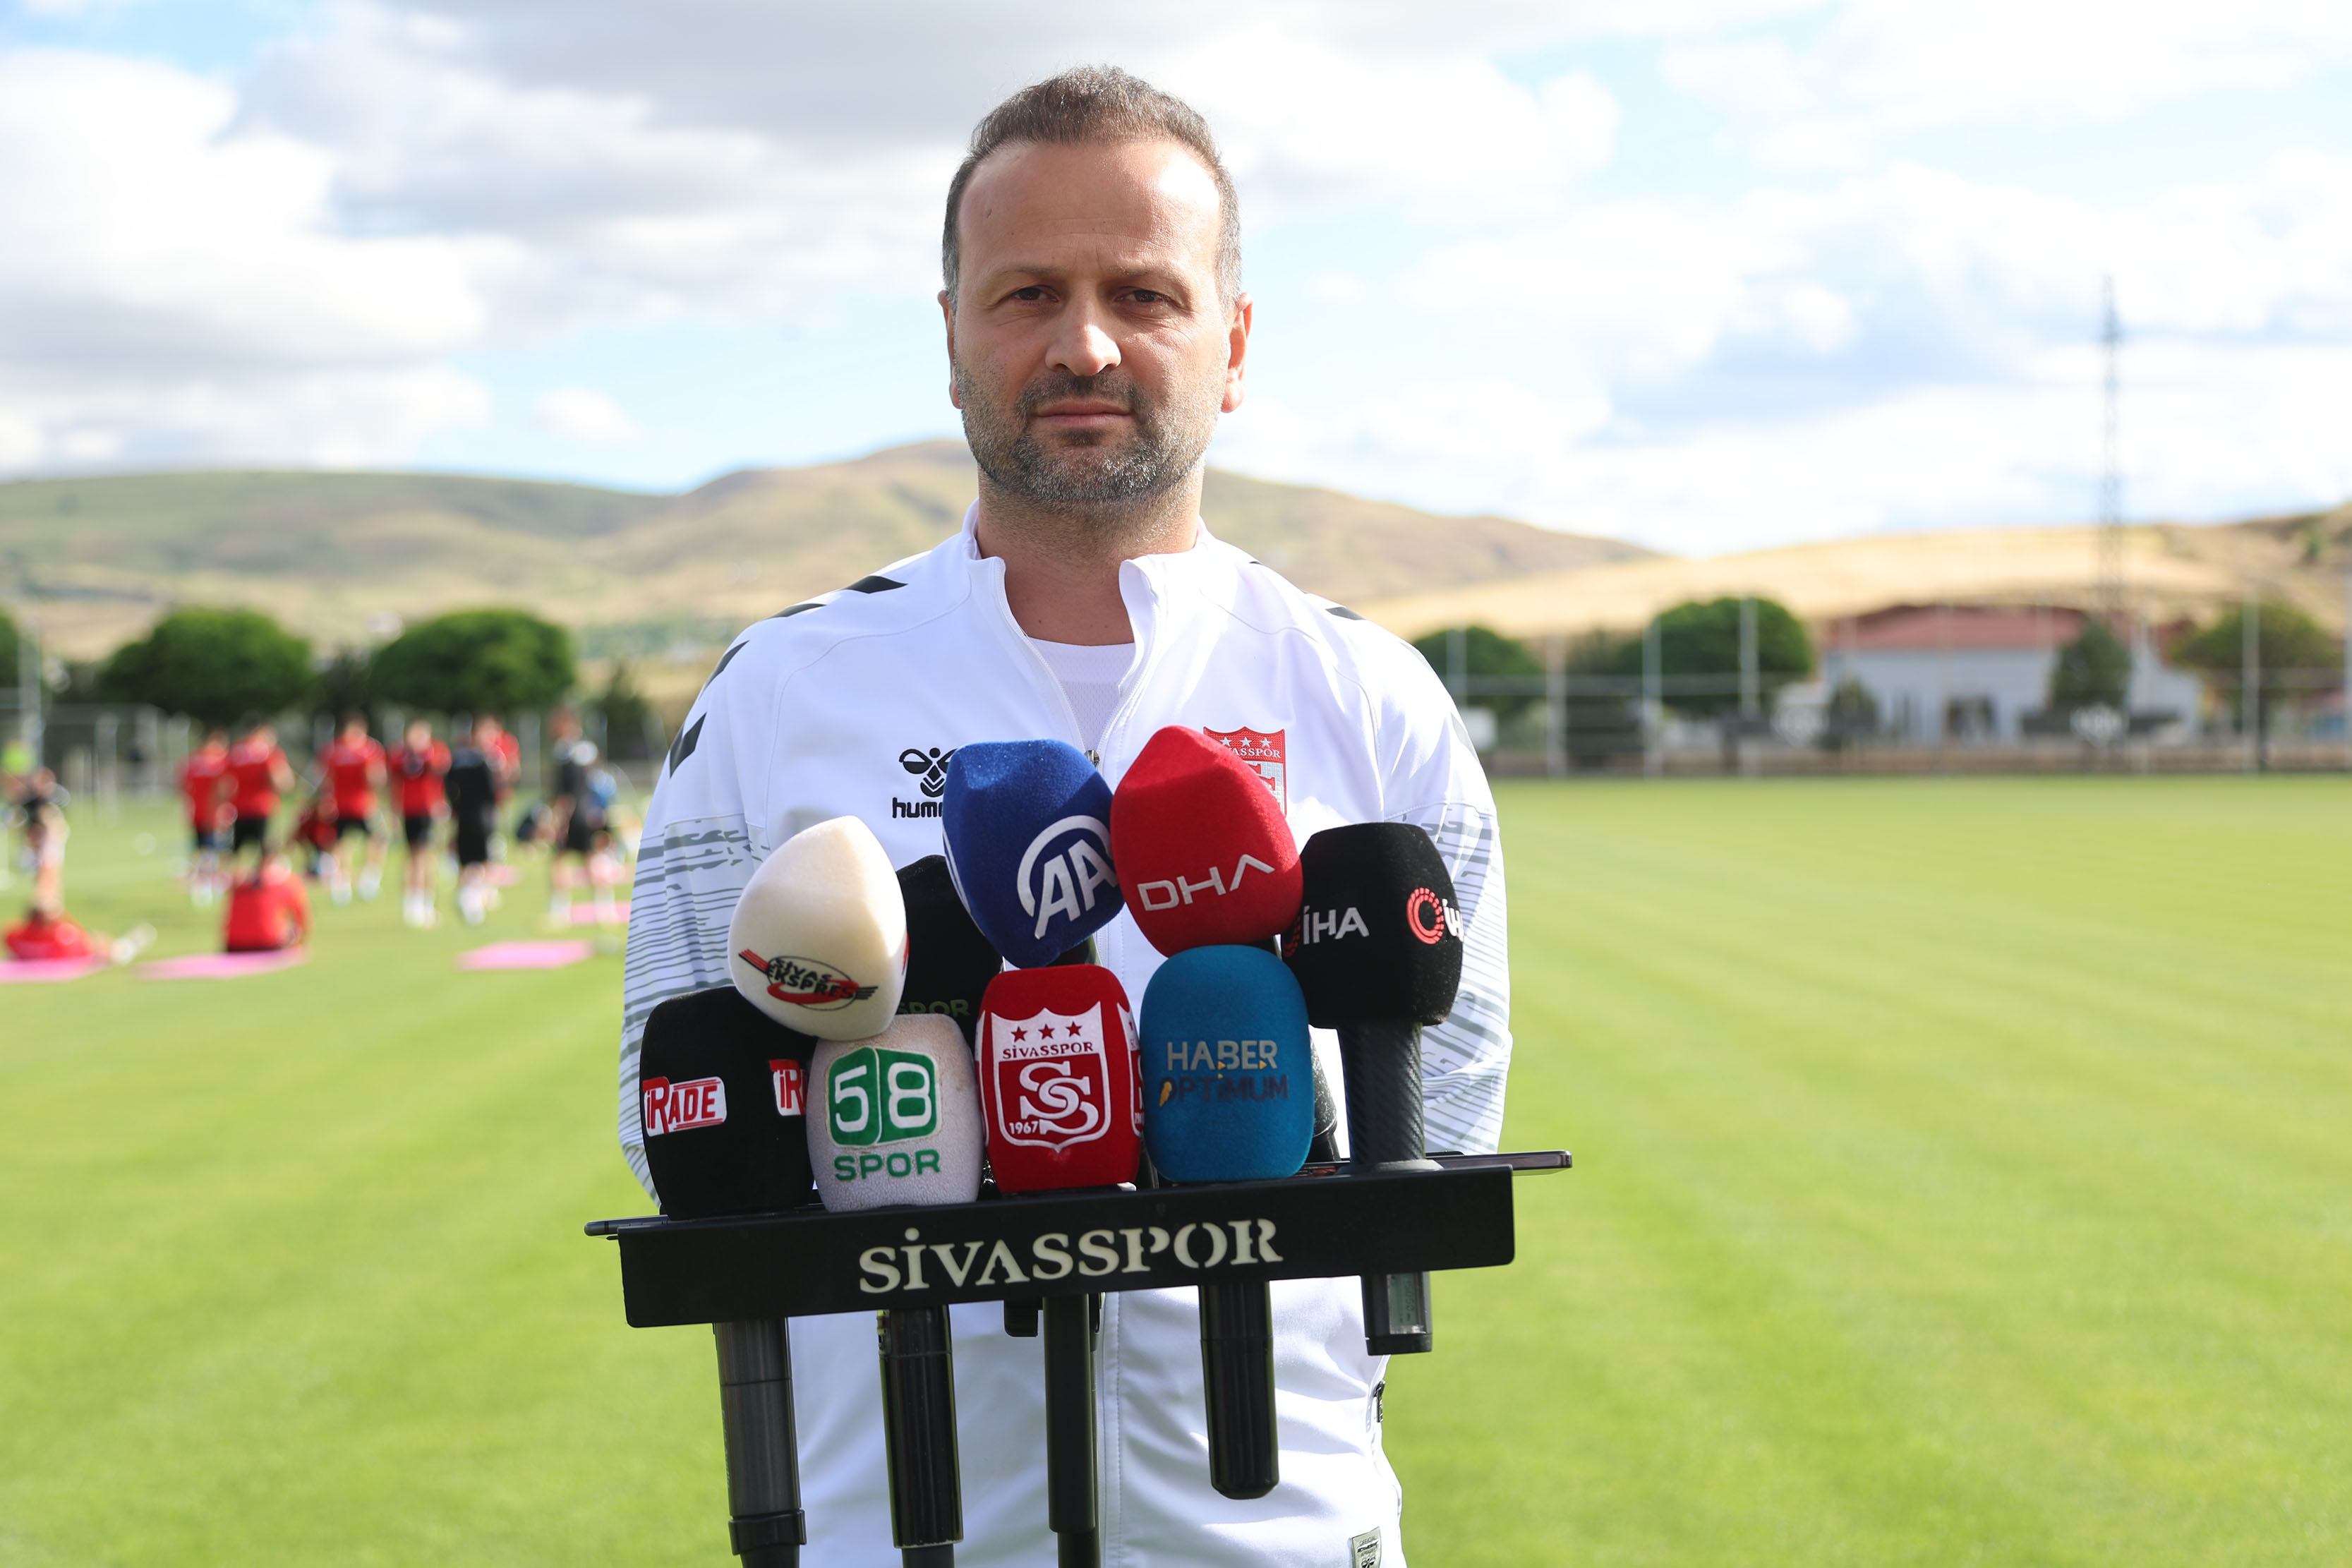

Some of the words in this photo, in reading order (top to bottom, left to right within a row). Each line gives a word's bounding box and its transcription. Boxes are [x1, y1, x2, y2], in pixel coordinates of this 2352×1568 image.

[1035, 839, 1118, 939] AA
[1138, 854, 1274, 911] DHA
[1303, 905, 1370, 944] İHA
[1442, 898, 1464, 942] İH
[1003, 1042, 1093, 1059] SİVASSPOR
[1167, 1039, 1277, 1071] HABER
[835, 1062, 931, 1133] 58
[1009, 1121, 1040, 1135] 1967
[834, 1150, 941, 1181] SPOR
[859, 1219, 1283, 1293] SİVASSPOR
